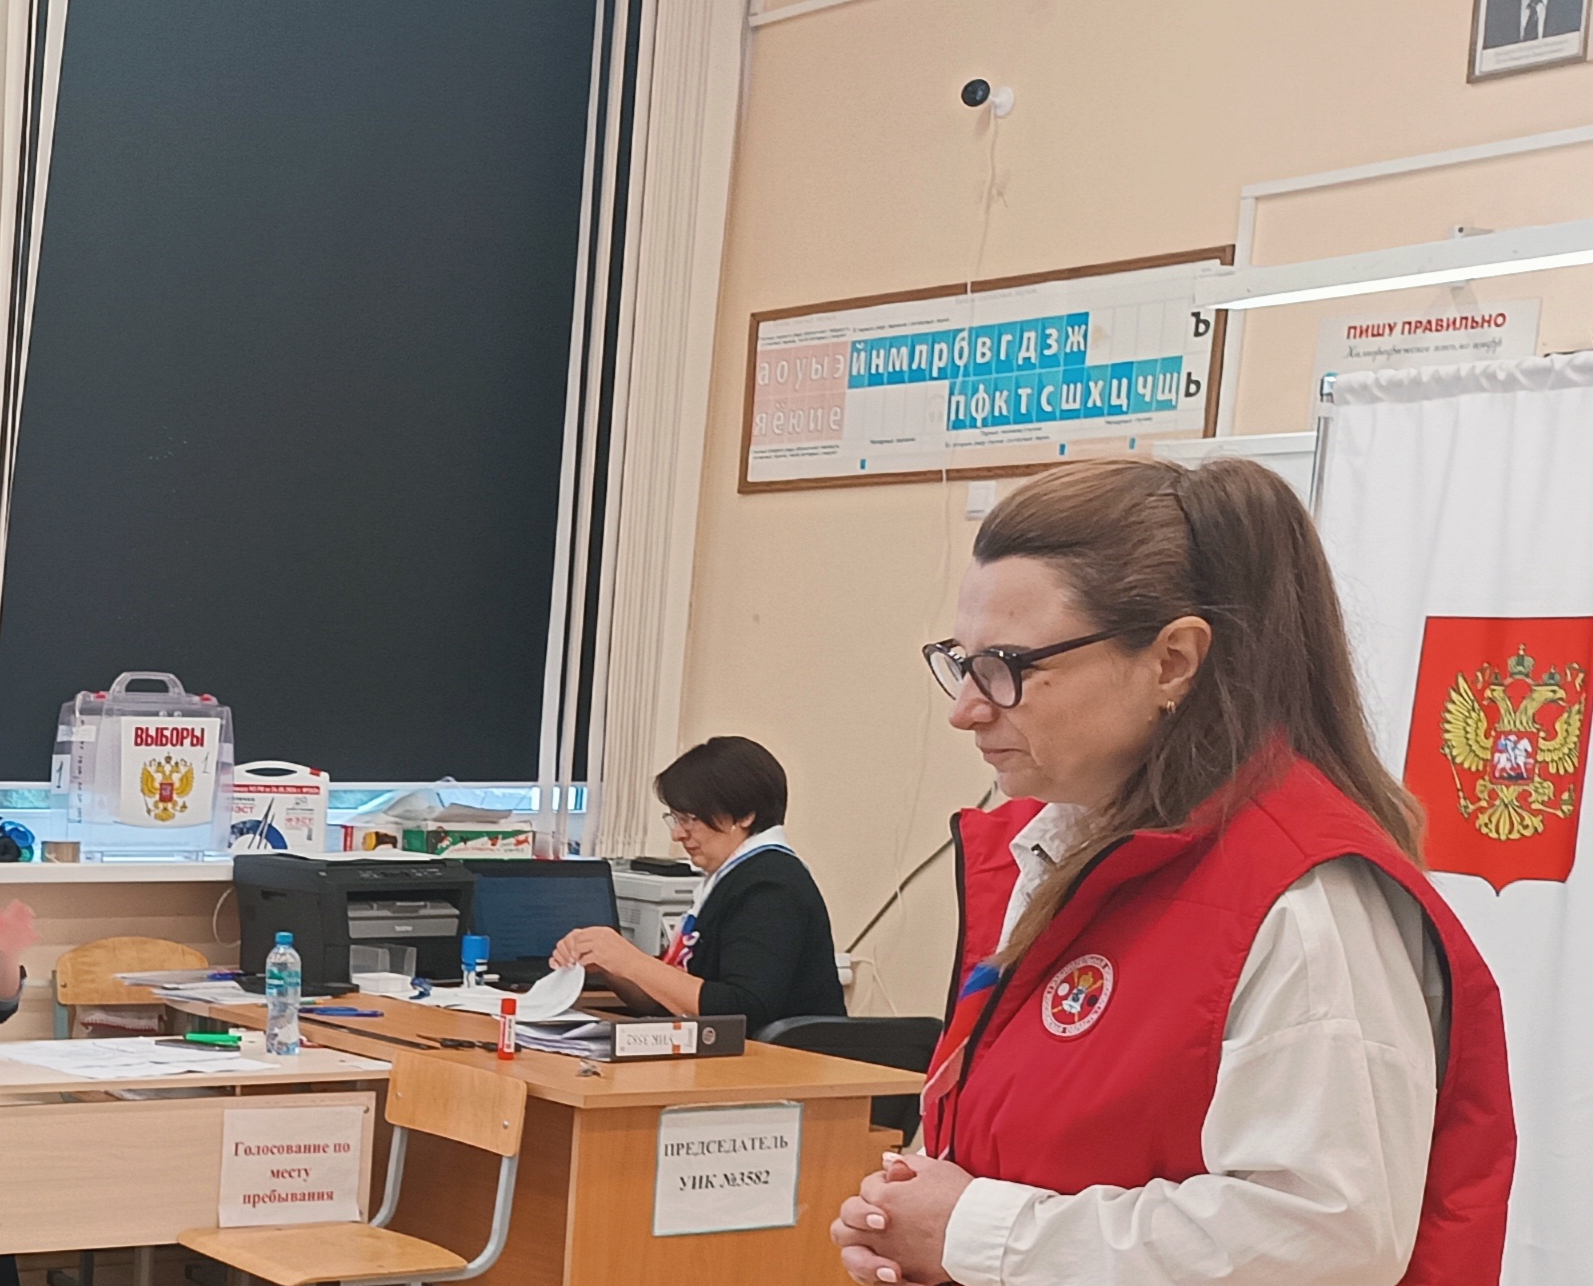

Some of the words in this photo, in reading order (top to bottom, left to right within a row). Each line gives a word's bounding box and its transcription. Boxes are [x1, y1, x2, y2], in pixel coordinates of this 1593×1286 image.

[1346, 322, 1397, 340] ПИШУ
[1401, 312, 1507, 335] ПРАВИЛЬНО
[134, 726, 205, 747] ВЫБОРЫ
[234, 1142, 330, 1157] Голосование
[333, 1142, 351, 1153] по
[664, 1135, 789, 1157] ПРЕДСЕДАТЕЛЬ
[270, 1168, 312, 1183] месту
[679, 1174, 717, 1191] УИК
[719, 1170, 771, 1188] №3582
[242, 1189, 334, 1208] пребывания
